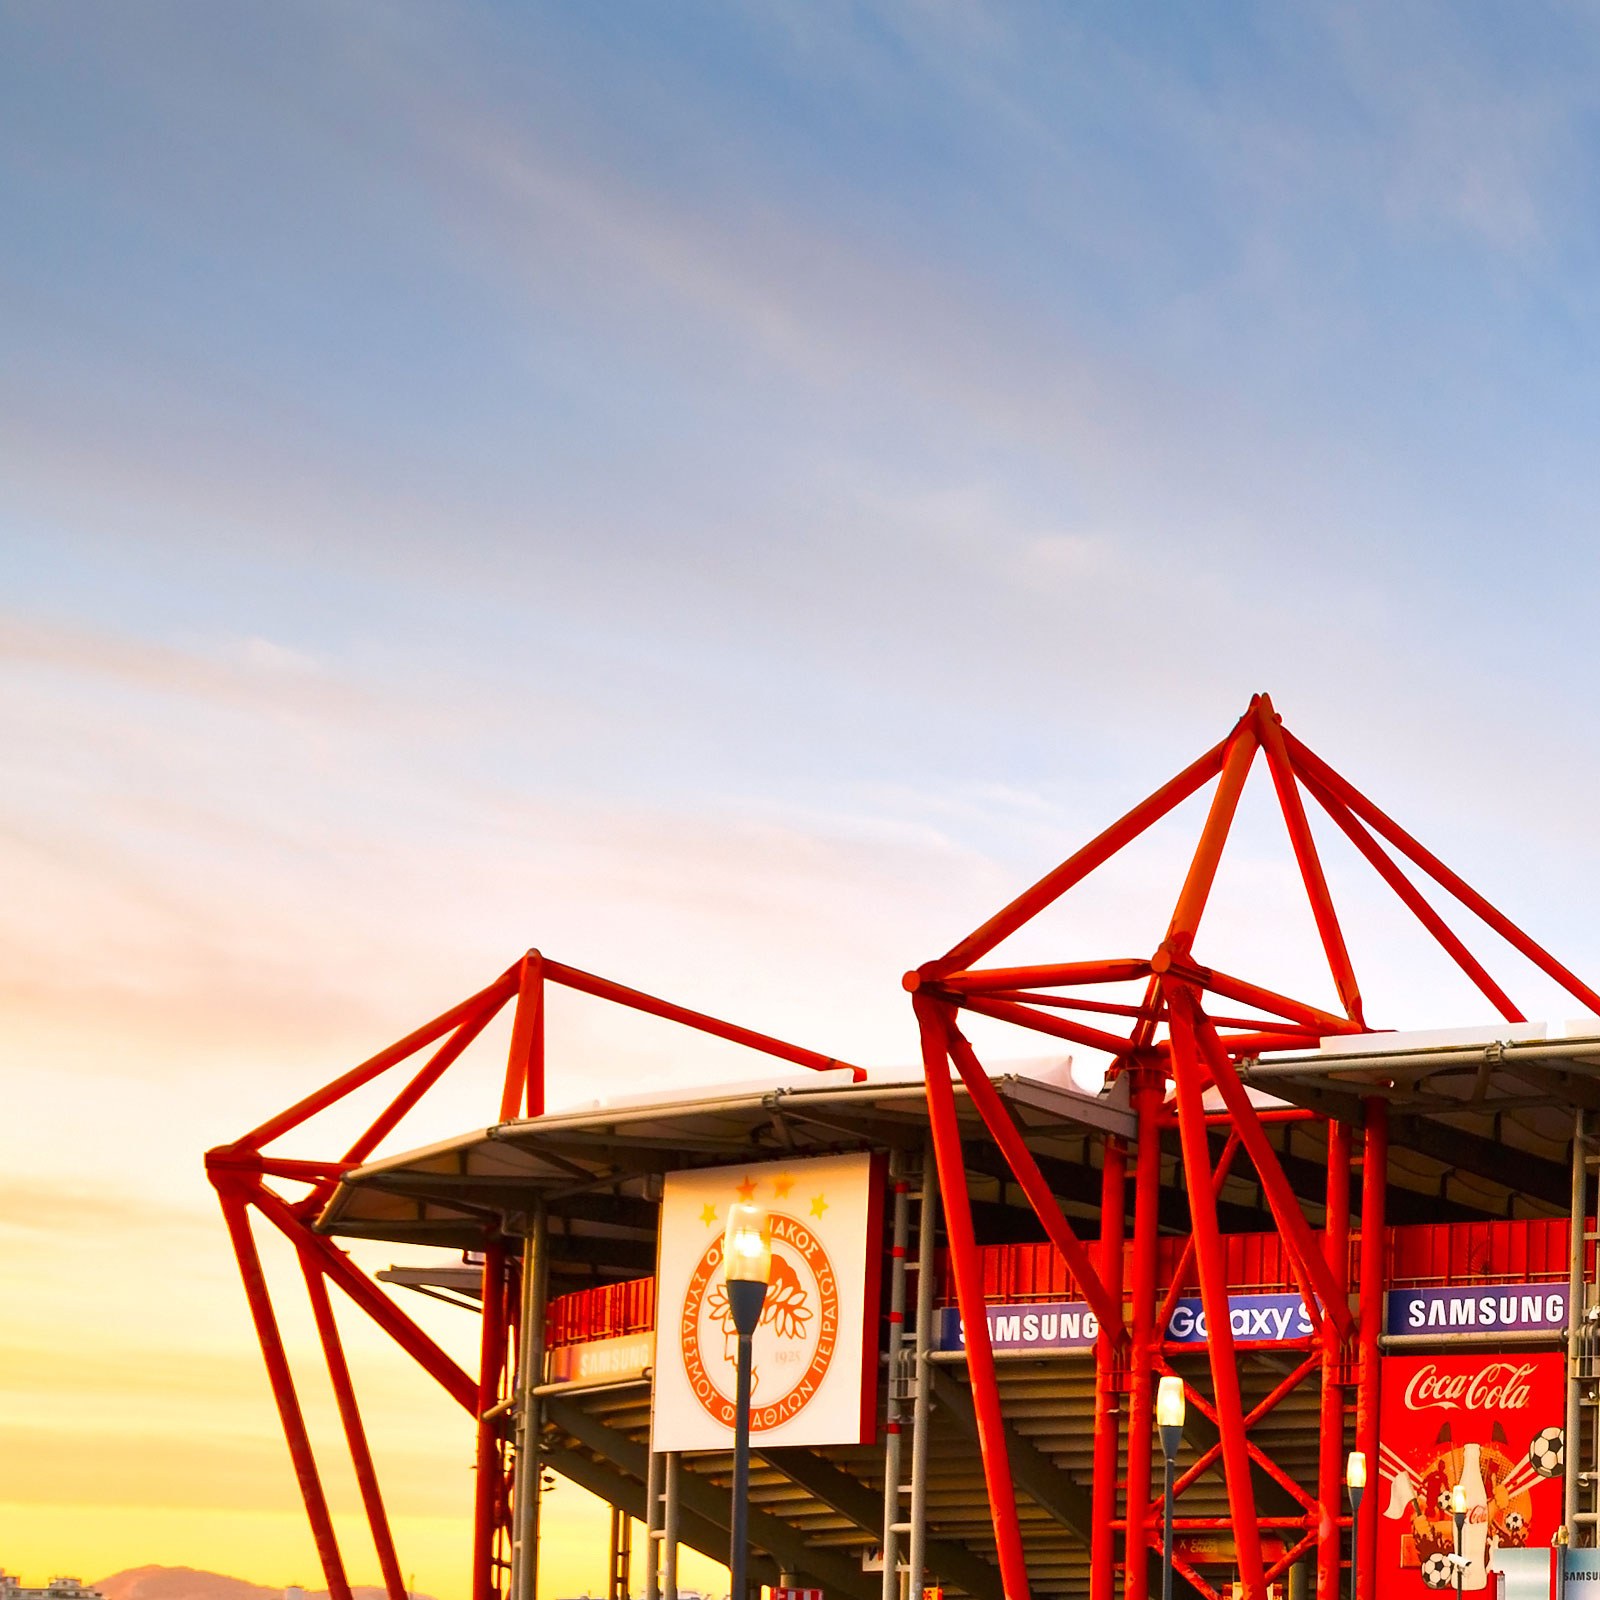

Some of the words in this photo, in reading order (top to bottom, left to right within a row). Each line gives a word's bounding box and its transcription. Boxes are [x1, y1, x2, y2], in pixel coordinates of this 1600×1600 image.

[812, 1265, 836, 1374] ΠΕΙΡΑΙΩΣ
[1408, 1295, 1564, 1327] SAMSUNG
[580, 1344, 651, 1377] SAMSUNG
[682, 1273, 716, 1408] ΣΥΝΔΕΣΜΟΣ
[721, 1381, 813, 1428] ΦΑΘΛΩΝ
[1404, 1362, 1539, 1410] Coca-Cola
